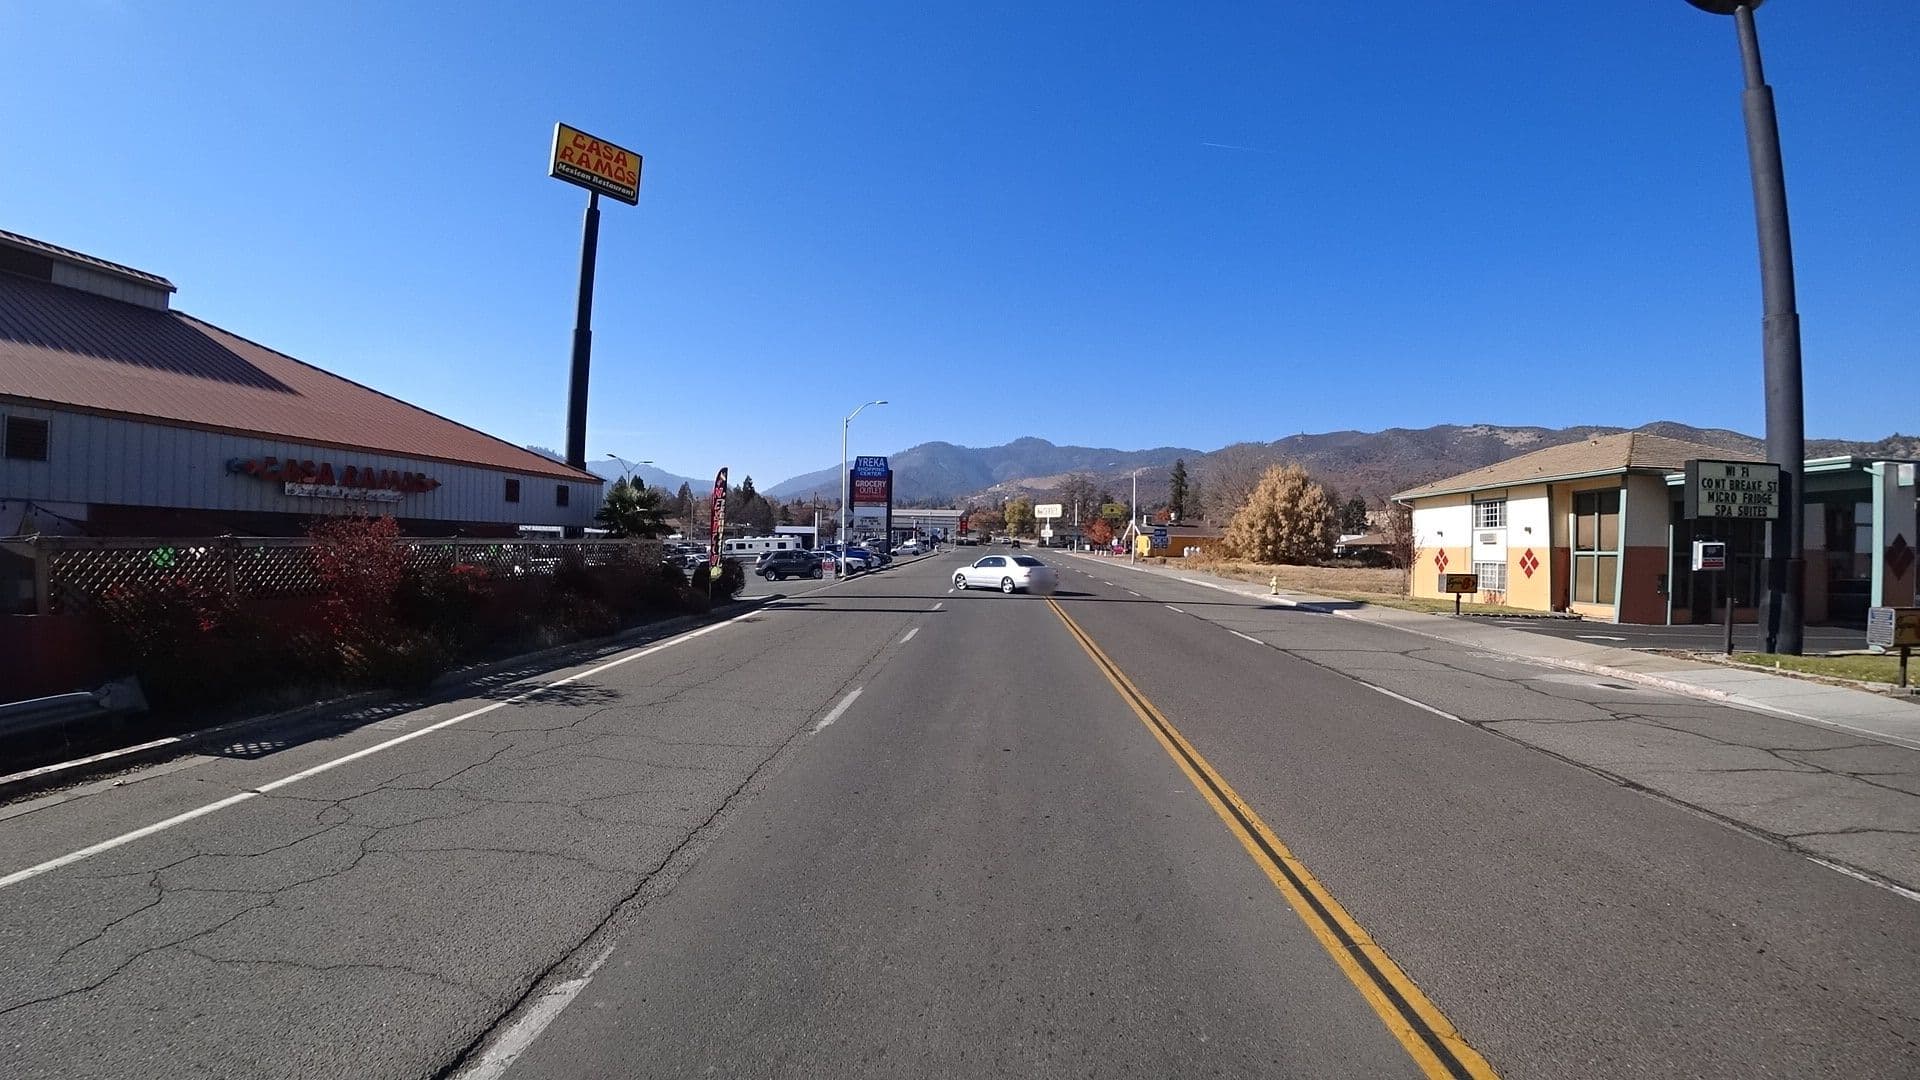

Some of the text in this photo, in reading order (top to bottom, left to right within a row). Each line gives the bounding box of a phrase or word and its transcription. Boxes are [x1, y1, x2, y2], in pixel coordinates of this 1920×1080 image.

[573, 135, 627, 167] CASA
[560, 146, 636, 185] RAMOS
[558, 163, 634, 197] Mexican Restaurant
[858, 457, 885, 467] YREKA
[1725, 465, 1750, 477] WI FI
[855, 480, 887, 488] GROCERY
[1701, 478, 1726, 489] CONT
[1767, 481, 1777, 492] ST
[1707, 491, 1773, 505] MICRO FRIDGE
[1715, 504, 1768, 517] SPA SUITES
